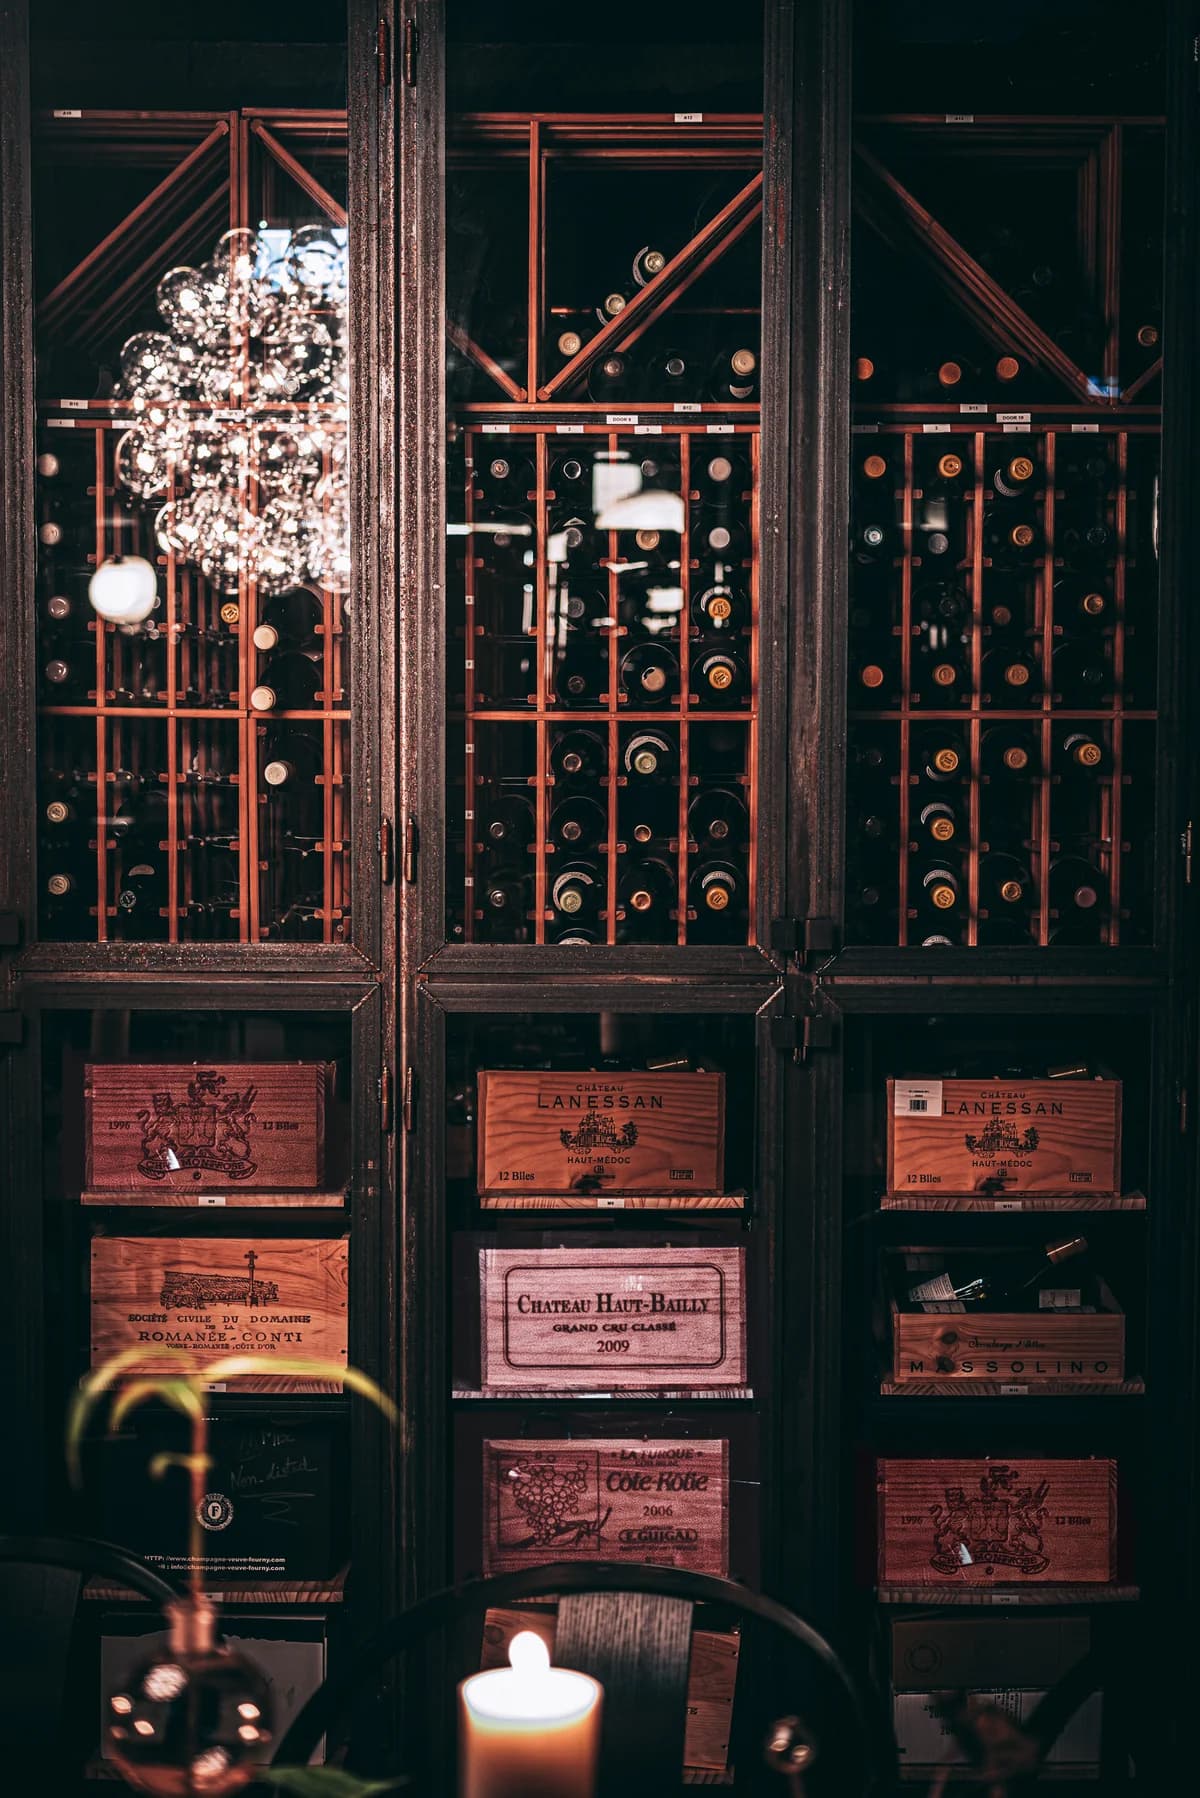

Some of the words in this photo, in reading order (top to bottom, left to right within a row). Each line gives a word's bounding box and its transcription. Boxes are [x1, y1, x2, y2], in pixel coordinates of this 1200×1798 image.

[576, 1083, 624, 1092] CHÂTEAU
[980, 1091, 1026, 1099] CHÂTEAU
[537, 1093, 664, 1109] LANESSAN
[943, 1100, 1064, 1115] LANESSAN
[109, 1121, 131, 1130] 1996
[263, 1121, 274, 1130] 12
[972, 1159, 1033, 1168] HAUT-MÉDOC
[499, 1171, 510, 1180] 12
[907, 1175, 918, 1183] 12
[517, 1294, 591, 1313] CHATEAU
[595, 1292, 710, 1313] HAUT-BAILLY
[177, 1315, 211, 1323] CIVILE
[222, 1315, 239, 1323] DU
[250, 1315, 311, 1324] DOMAINE
[553, 1323, 599, 1333] GRAND
[602, 1323, 628, 1333] CRU
[631, 1321, 677, 1332] CLASSÉ
[597, 1340, 630, 1353] 2009
[910, 1361, 1109, 1374] MASSOLINO
[620, 1450, 638, 1460] LA
[606, 1471, 709, 1492] Côte-Rôtie
[643, 1505, 673, 1517] 2006
